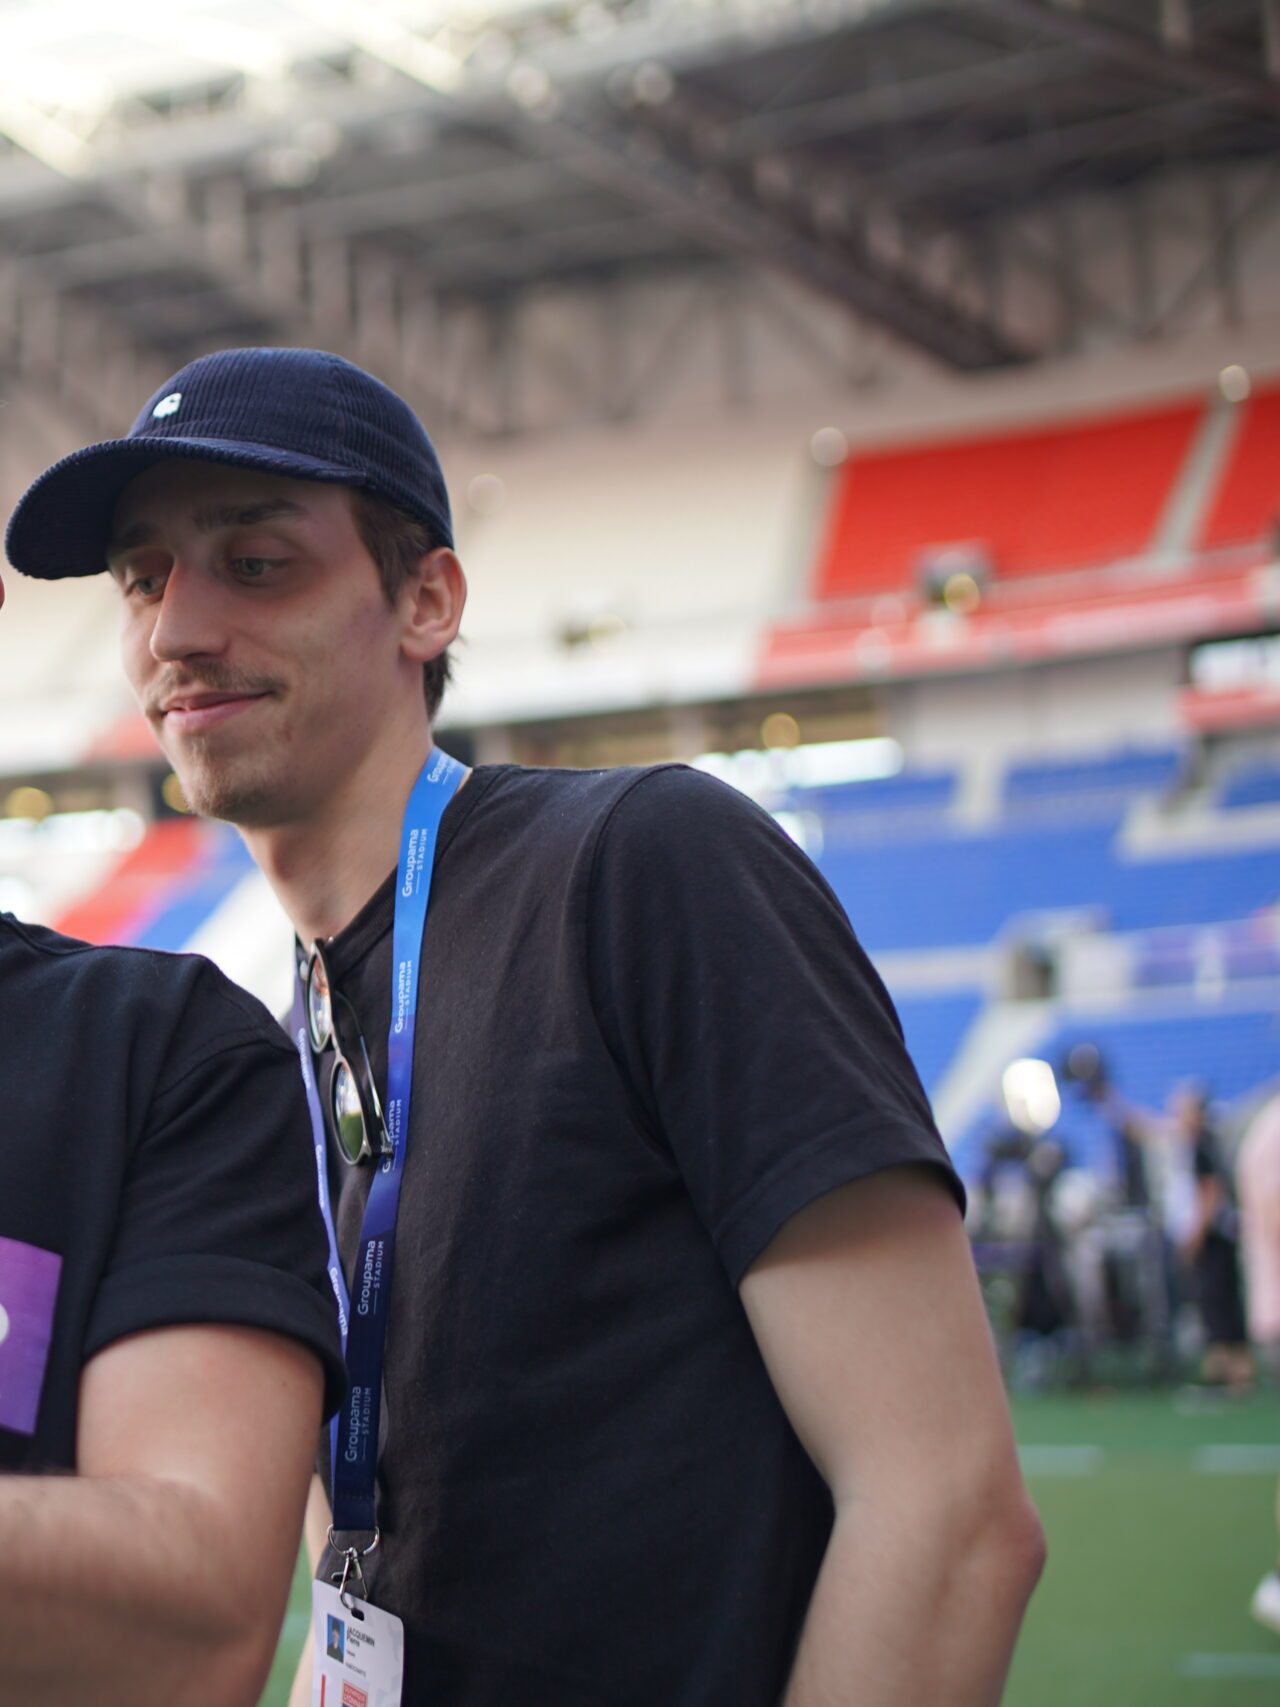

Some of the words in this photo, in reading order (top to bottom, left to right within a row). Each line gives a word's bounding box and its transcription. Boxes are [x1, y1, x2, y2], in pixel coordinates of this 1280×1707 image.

[402, 829, 419, 897] Groupama
[416, 828, 427, 870] STADIUM
[395, 962, 408, 1033] Groupama
[394, 1099, 402, 1146] STADIUM
[357, 1240, 376, 1315] Groupama
[373, 1241, 384, 1288] STADIUM
[344, 1386, 362, 1461] Groupama
[361, 1387, 372, 1434] STADIUM
